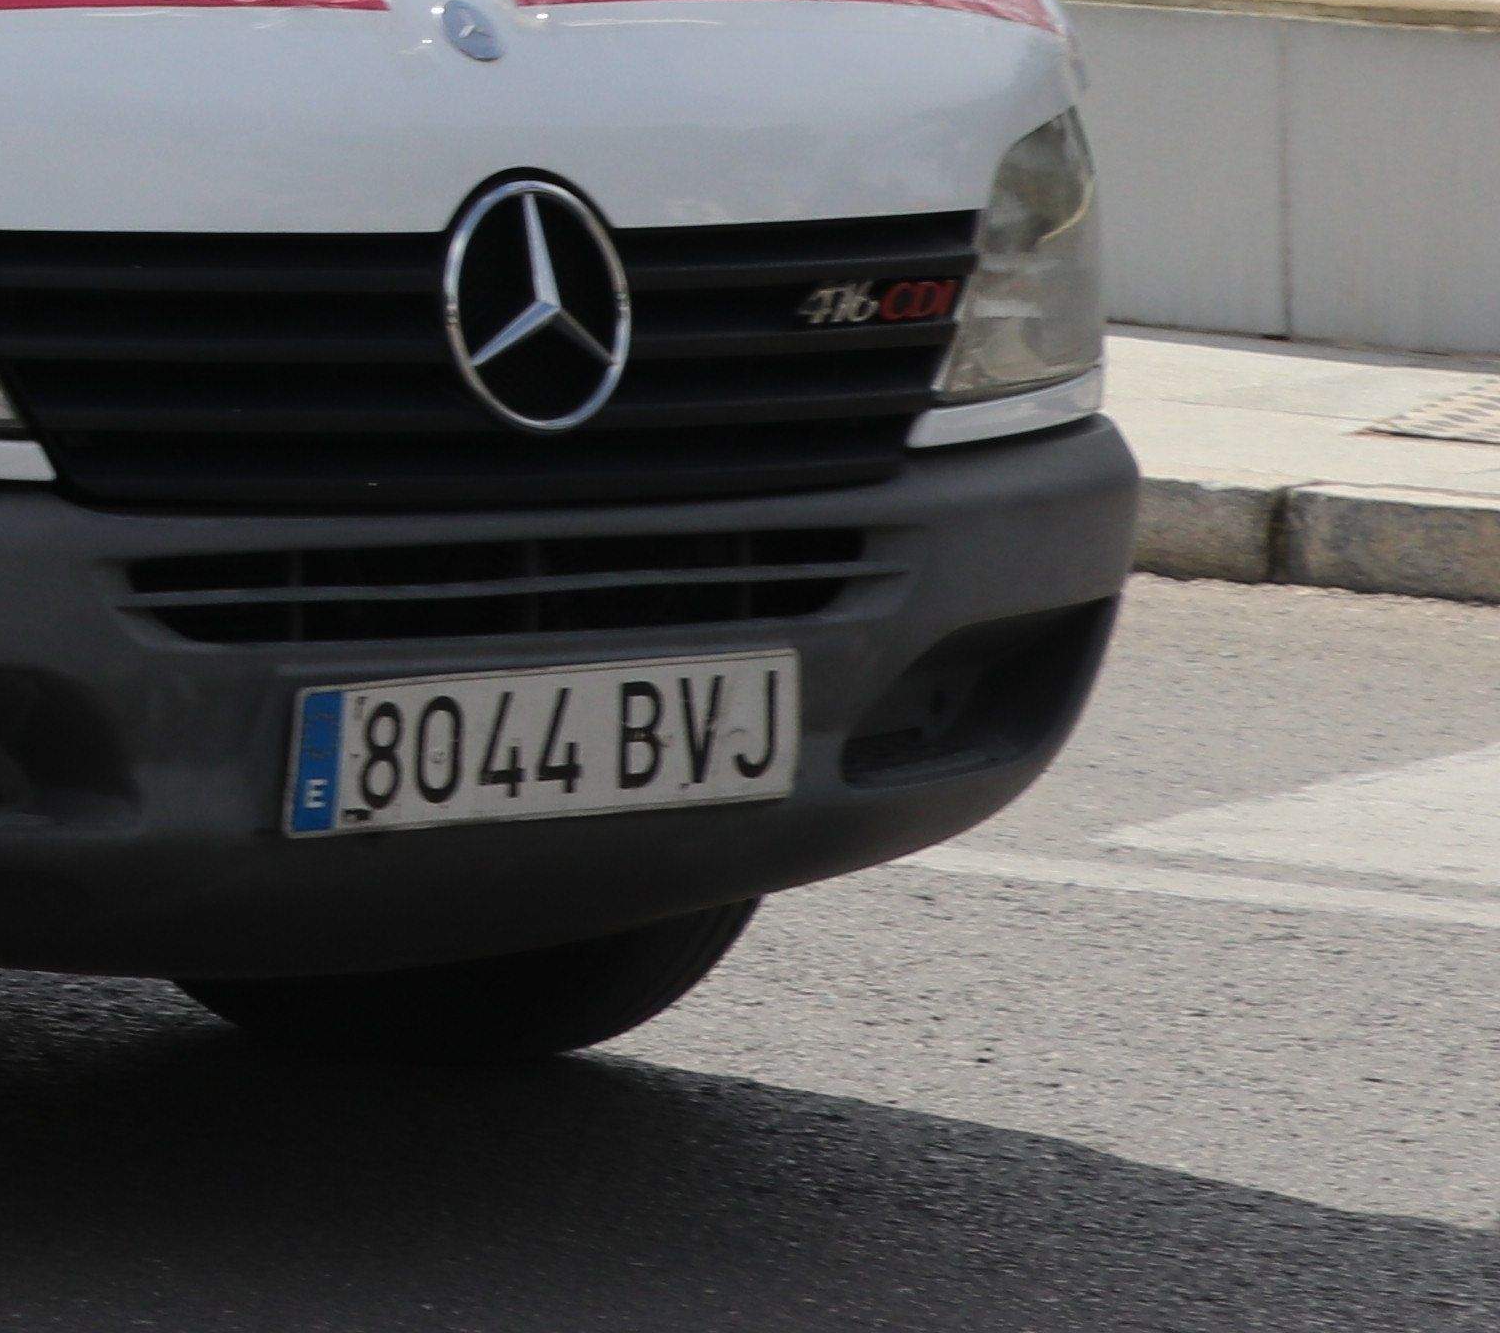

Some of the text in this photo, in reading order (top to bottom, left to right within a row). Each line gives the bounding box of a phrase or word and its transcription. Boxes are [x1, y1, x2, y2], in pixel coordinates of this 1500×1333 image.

[879, 279, 960, 323] CDI
[358, 669, 780, 809] 8044 BVJ
[303, 778, 329, 810] E
